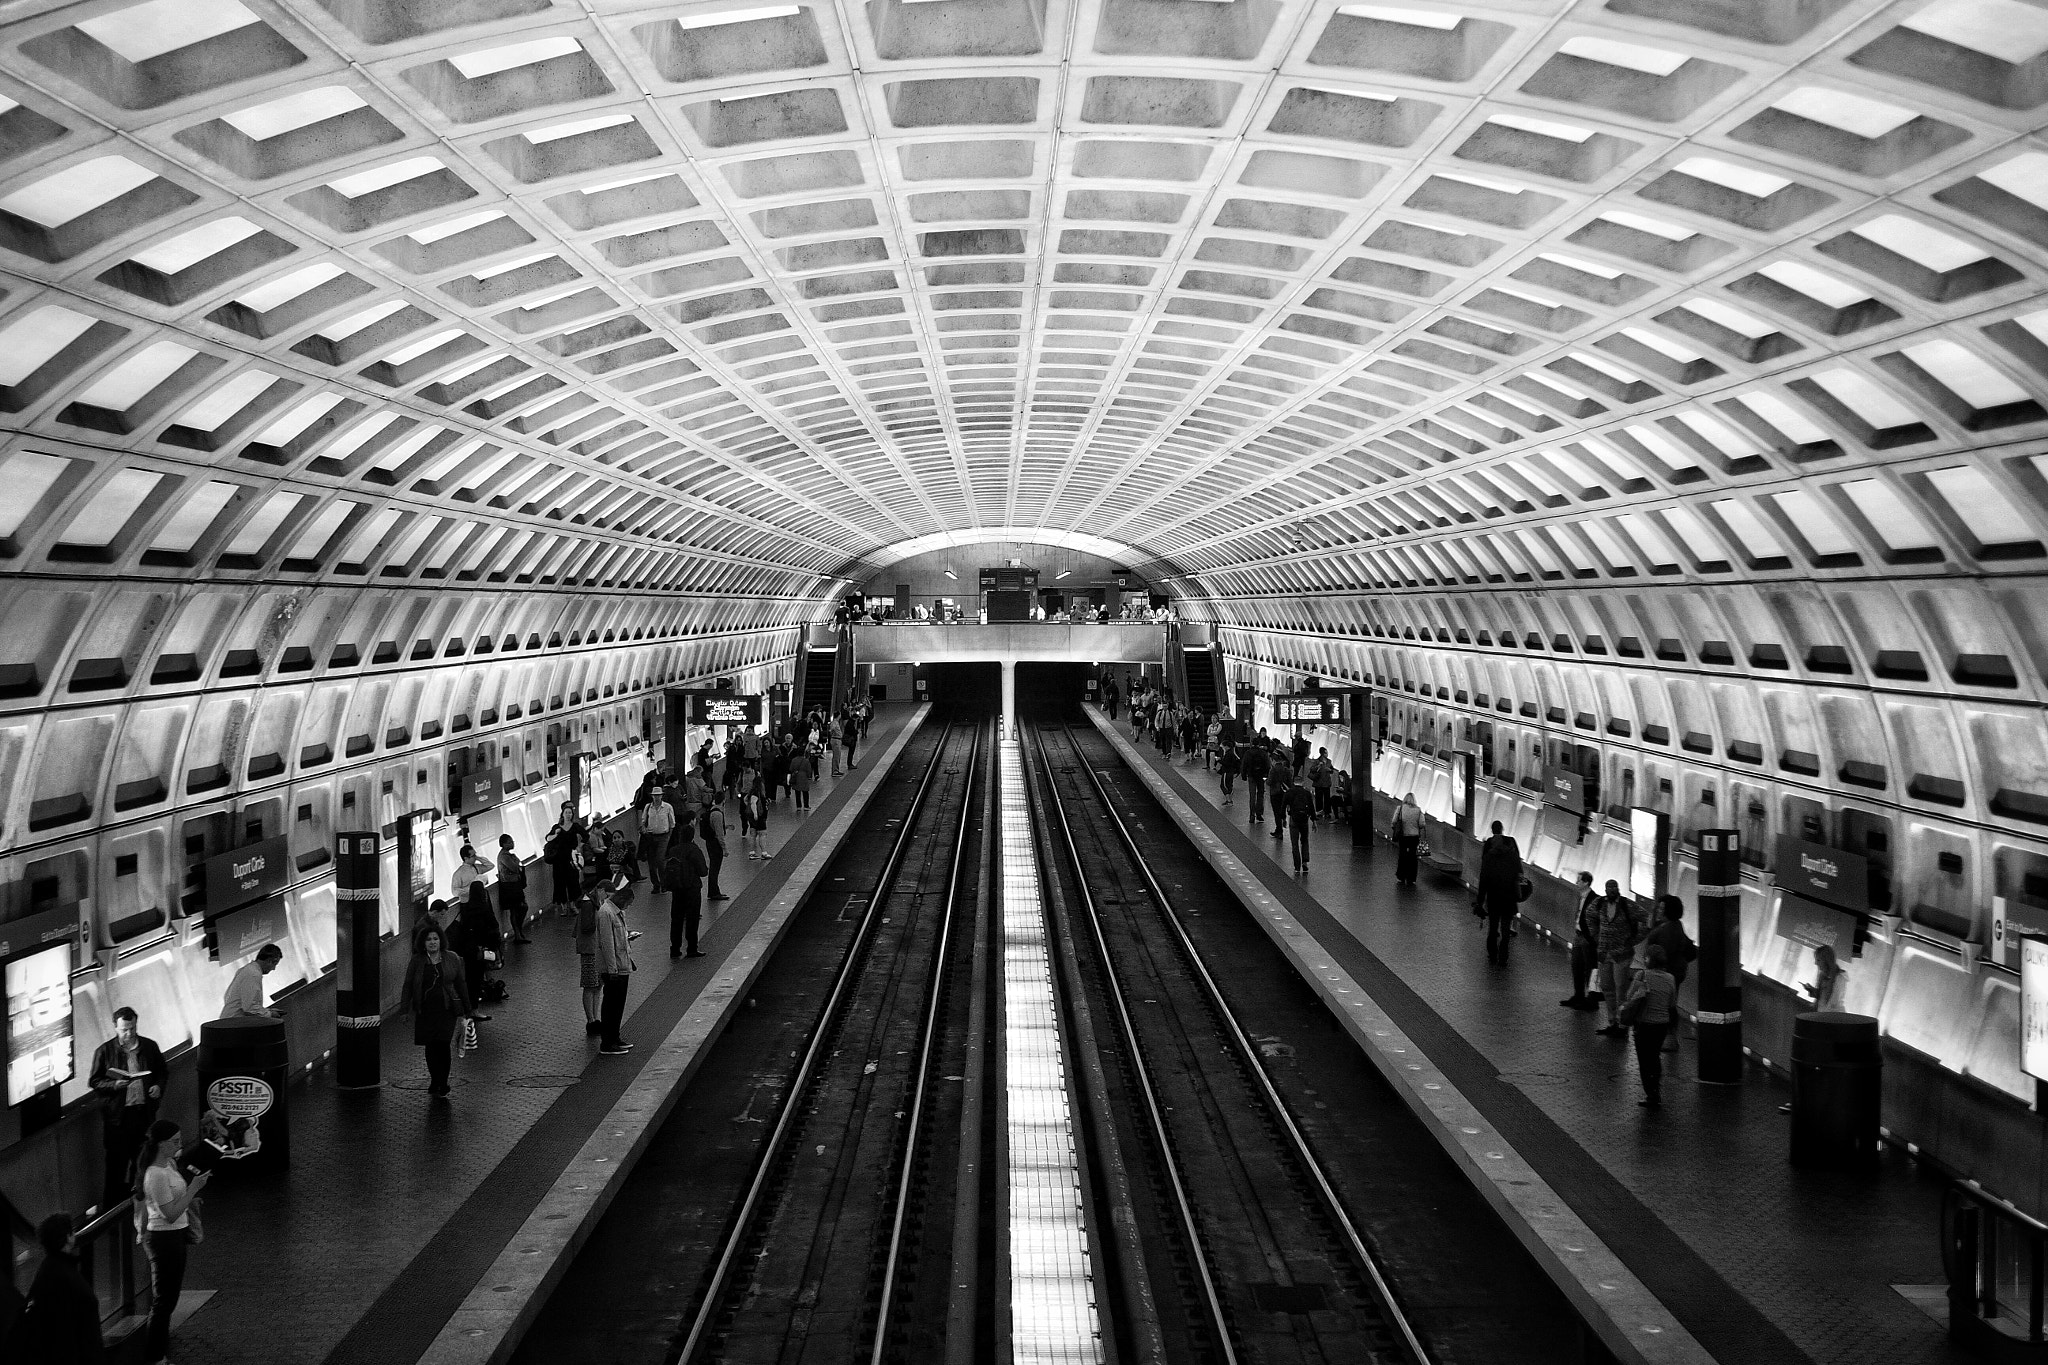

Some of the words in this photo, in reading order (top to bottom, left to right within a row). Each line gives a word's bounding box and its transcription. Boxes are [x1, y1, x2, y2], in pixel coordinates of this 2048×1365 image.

[233, 860, 251, 880] Dupont
[251, 855, 265, 872] Circle
[219, 1081, 254, 1094] PSST!
